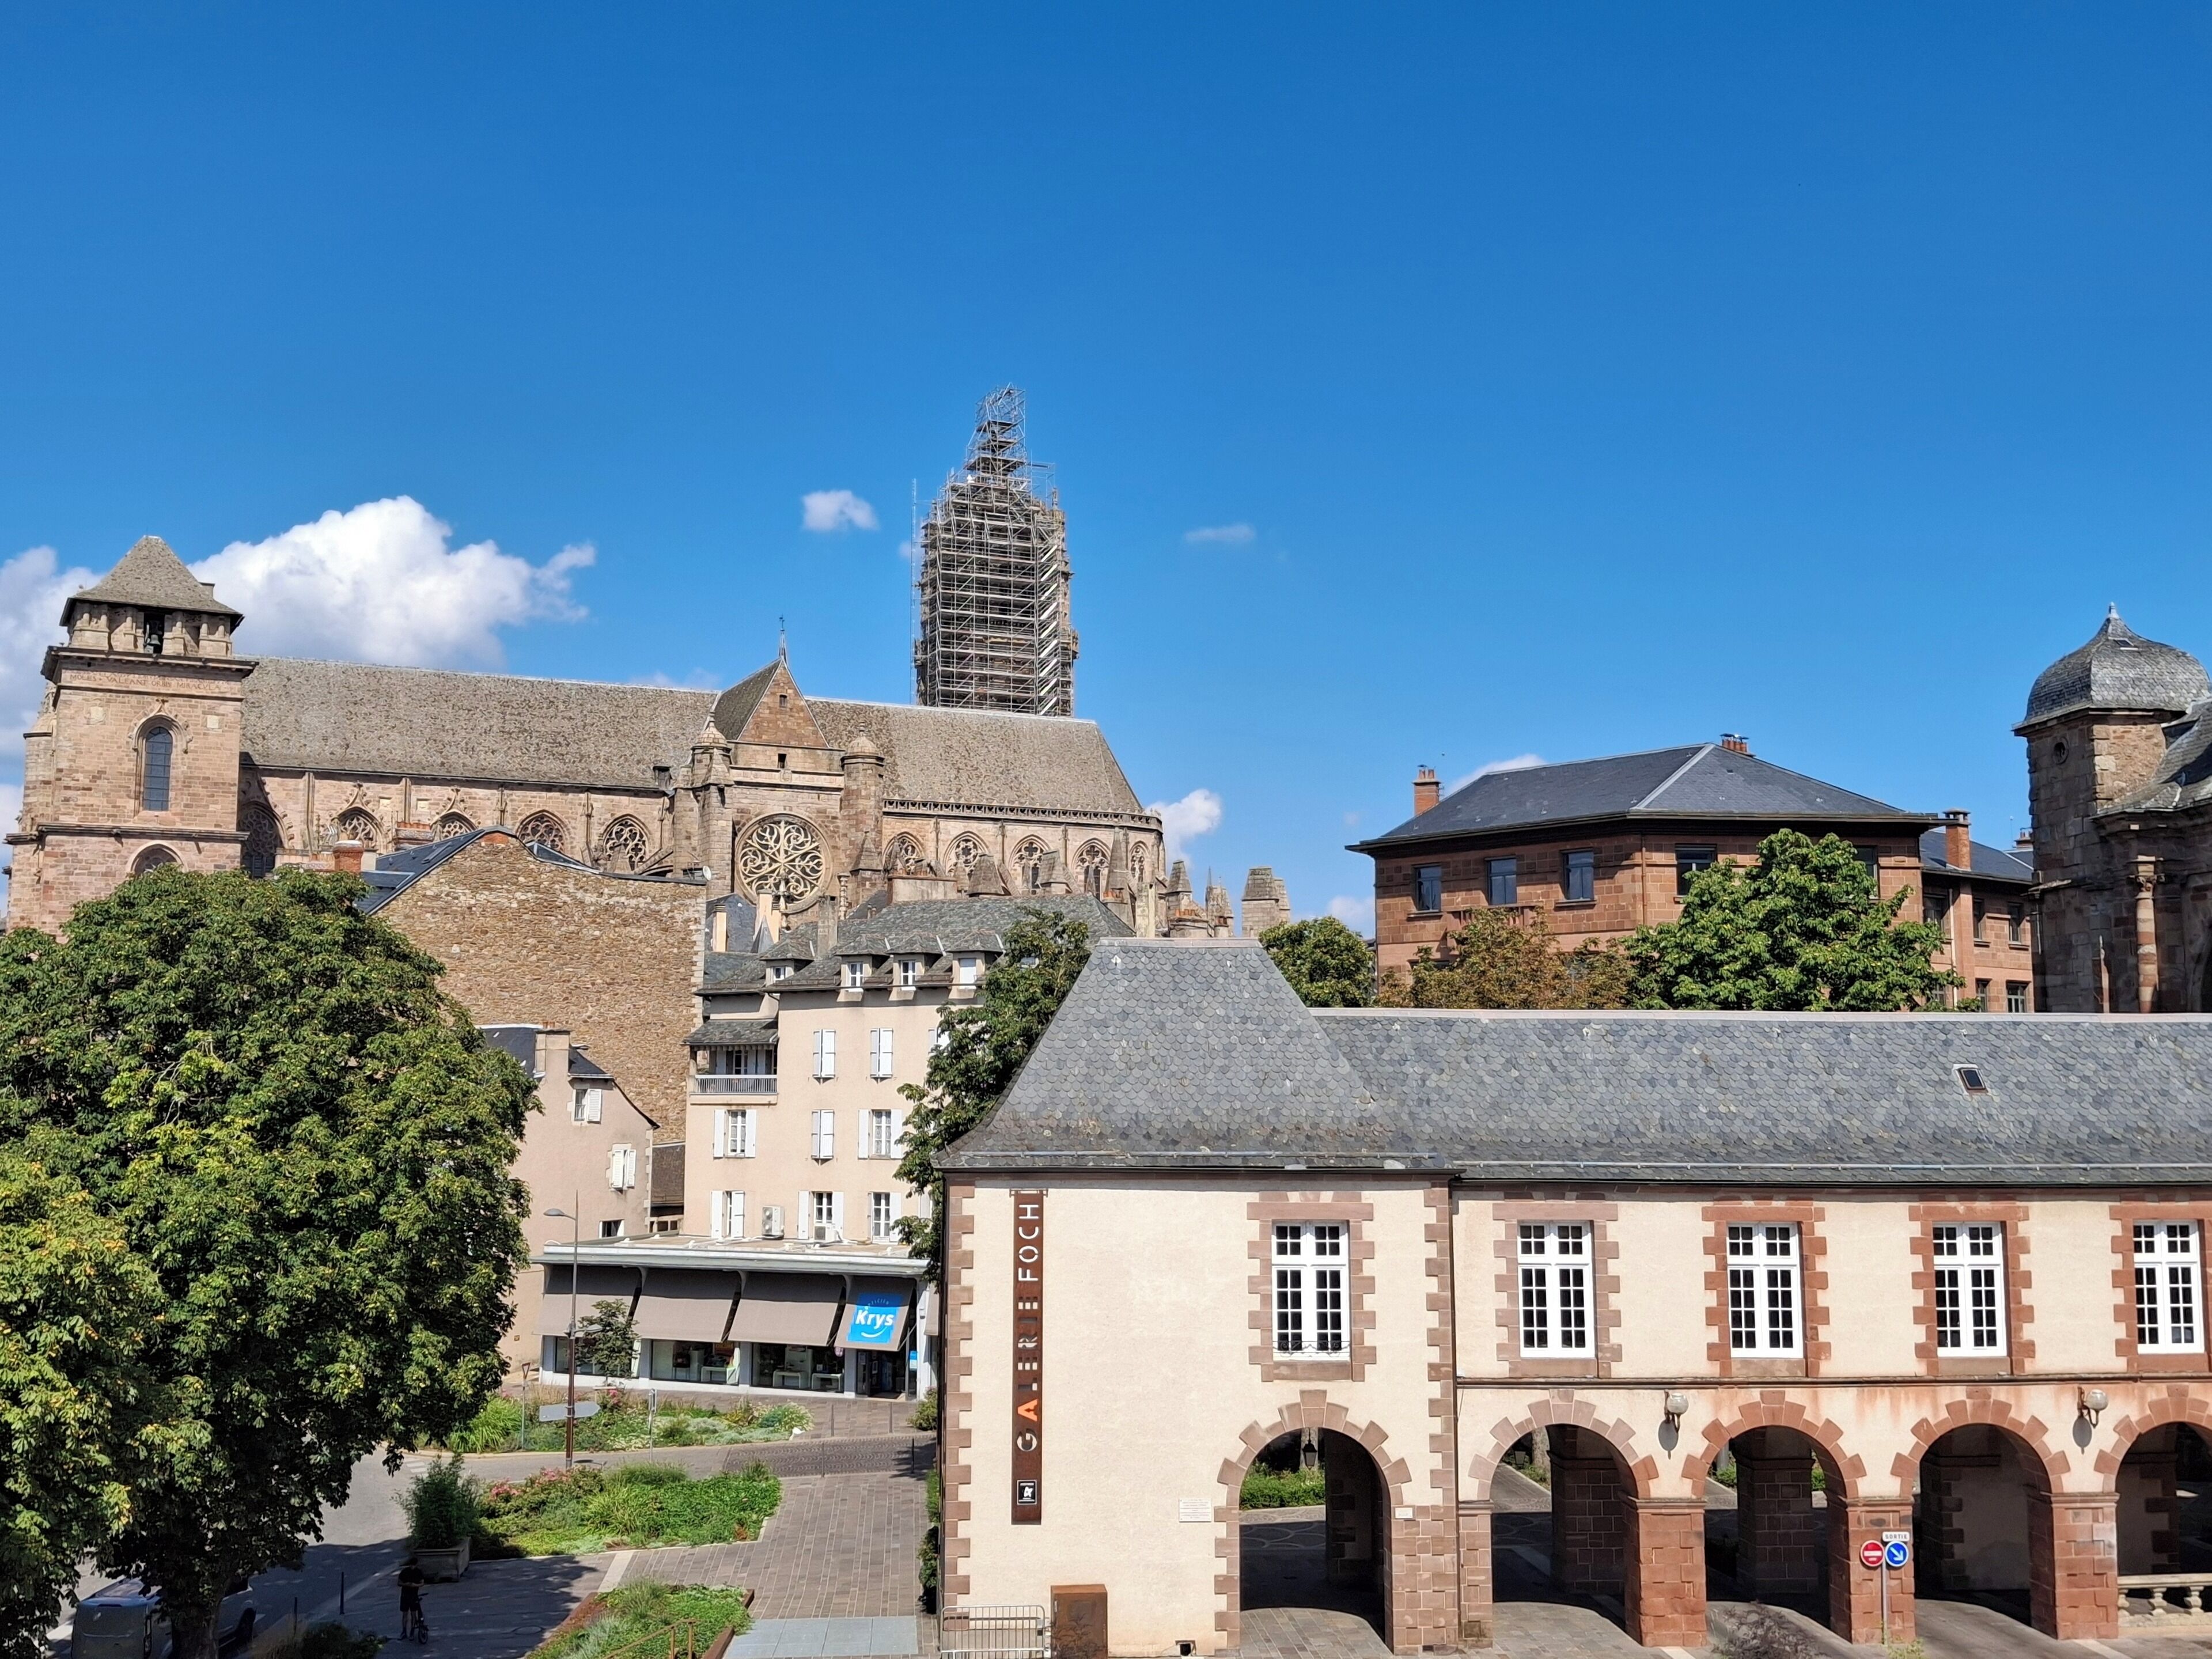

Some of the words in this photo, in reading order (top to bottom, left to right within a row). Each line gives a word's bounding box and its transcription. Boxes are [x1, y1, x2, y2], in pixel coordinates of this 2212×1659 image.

[106, 676, 148, 686] VALEANT
[1018, 1205, 1039, 1281] FOCH
[855, 1309, 895, 1330] Krys
[1017, 1296, 1038, 1452] GALERIE
